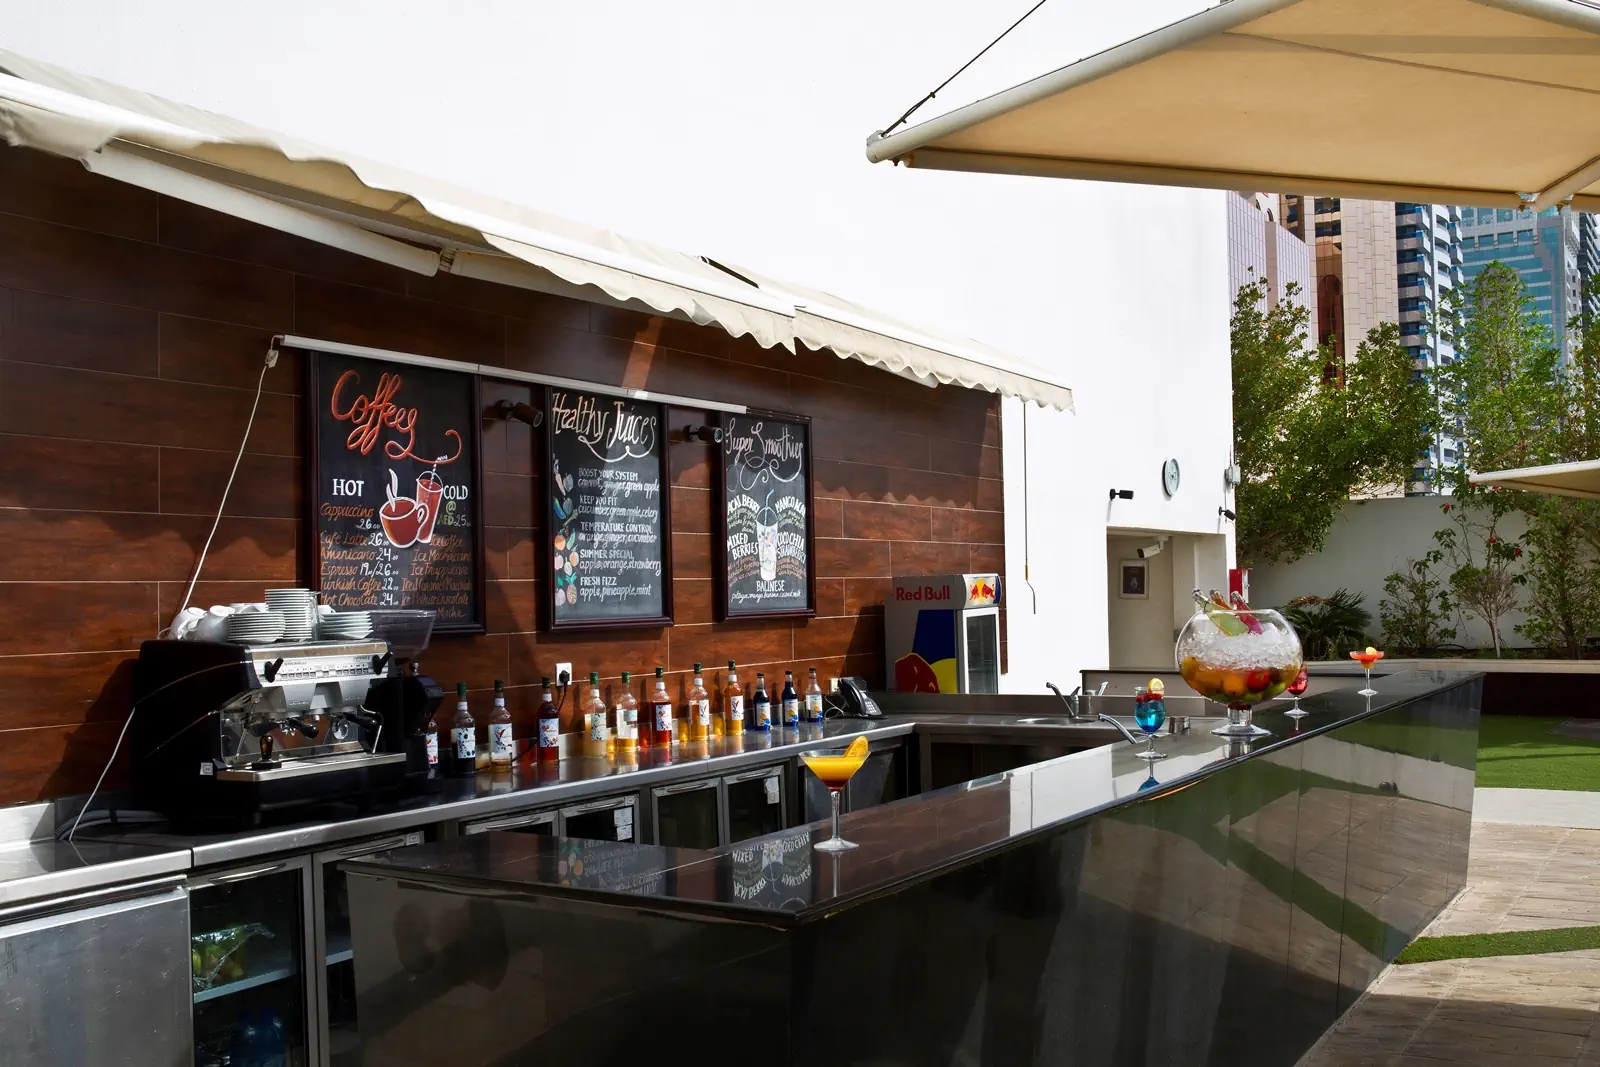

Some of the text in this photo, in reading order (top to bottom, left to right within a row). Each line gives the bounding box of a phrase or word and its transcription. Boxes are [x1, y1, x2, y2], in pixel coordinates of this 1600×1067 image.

[552, 392, 657, 450] Healthy Juices
[726, 417, 754, 466] Super
[578, 467, 638, 481] BOOST YOUR SYSTEM
[332, 478, 365, 497] HOT
[443, 484, 469, 500] COLD
[445, 500, 457, 515] @
[580, 495, 618, 506] KEEP YOU FIT
[319, 502, 375, 521] Cappuccino
[580, 521, 653, 534] TEMPERATURE CONTROL
[343, 531, 368, 546] Latte
[727, 533, 749, 551] MIXED
[319, 547, 377, 560] Americano
[413, 548, 428, 562] Ice
[580, 549, 634, 560] SUMMER SPECIAL
[732, 542, 758, 560] BERRIES
[319, 561, 359, 578] Espresso
[410, 561, 425, 576] Ice
[319, 577, 356, 590] Turkish
[357, 577, 382, 596] Coffee
[580, 576, 617, 586] FRESH FIZZ
[756, 580, 785, 592] BALINESE
[320, 593, 338, 606] Hot
[338, 592, 378, 606] Chocolate
[896, 585, 950, 601] Red Bull
